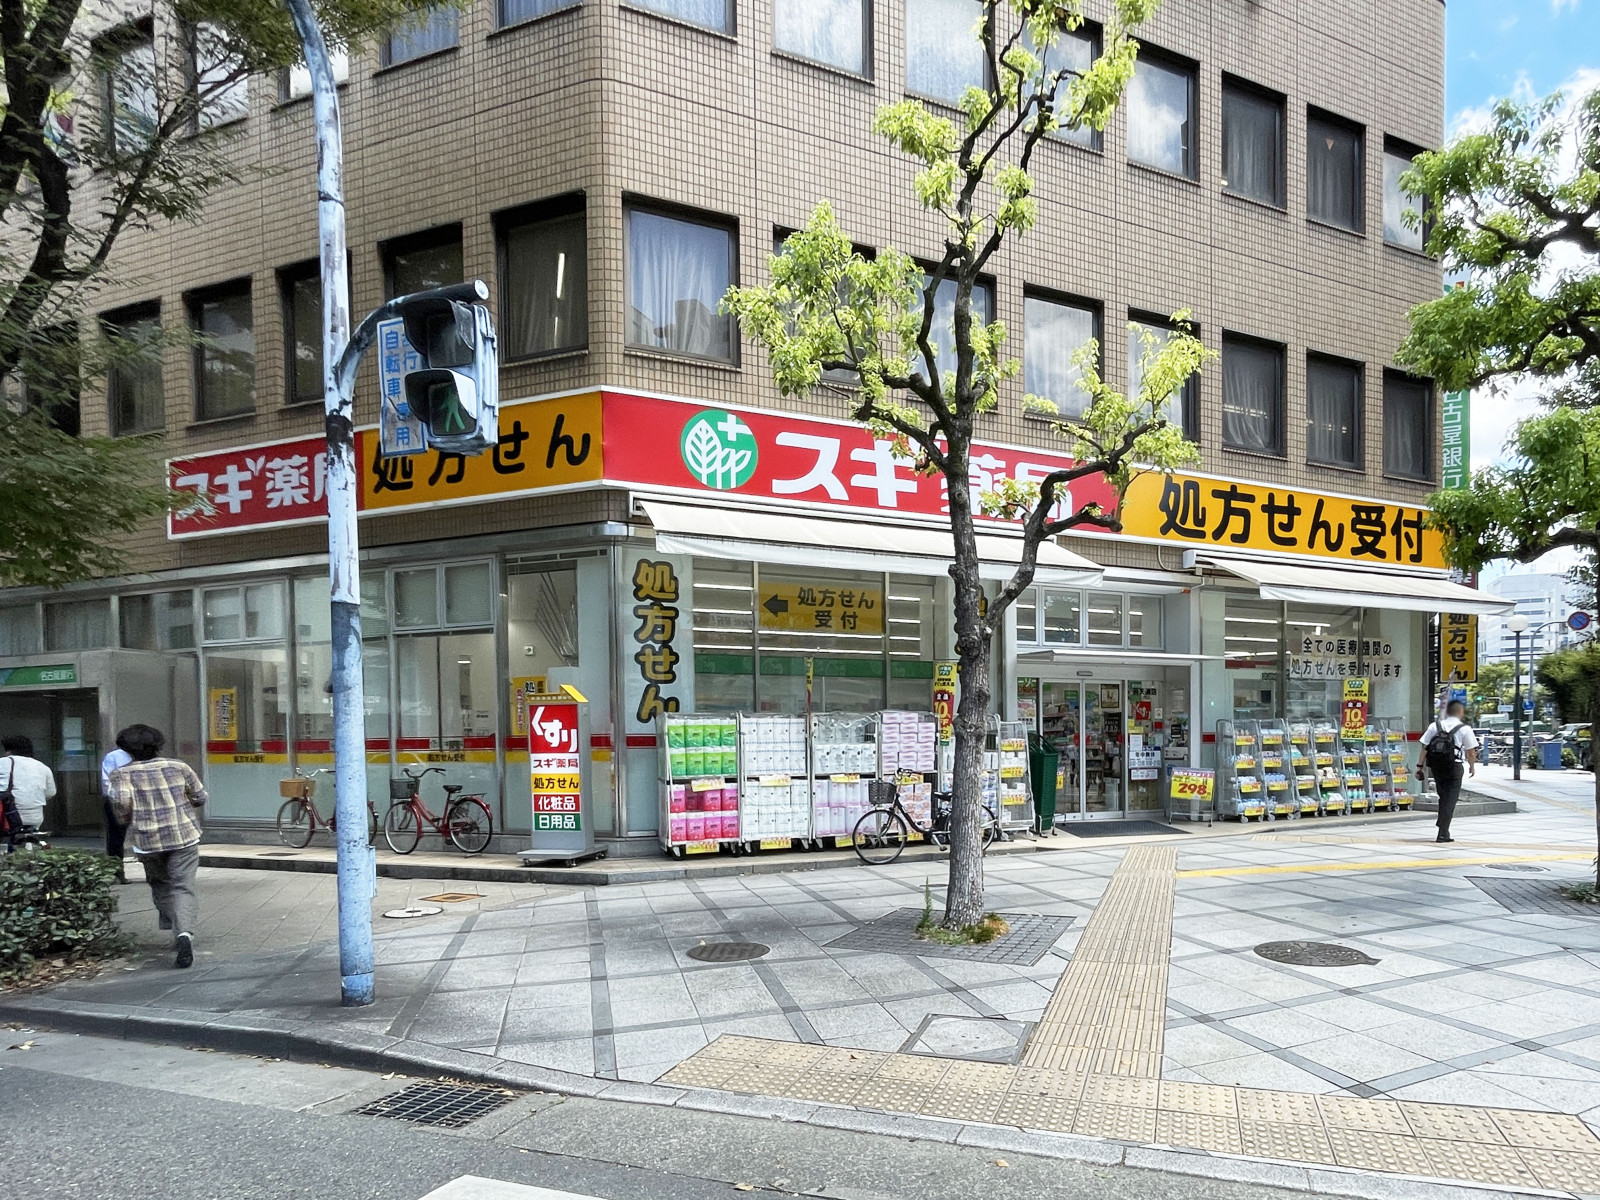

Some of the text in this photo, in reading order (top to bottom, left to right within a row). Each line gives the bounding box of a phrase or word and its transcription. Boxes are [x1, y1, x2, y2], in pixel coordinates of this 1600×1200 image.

[385, 330, 400, 397] 自転車
[1159, 474, 1426, 563] 処方せん受付
[797, 587, 875, 610] 処方せん
[814, 610, 859, 630] 受付
[633, 558, 680, 723] 処方せん
[531, 706, 578, 753] くすり
[533, 758, 579, 769] スギ薬局
[533, 777, 579, 789] 処方せん
[1178, 783, 1207, 795] 298
[538, 796, 576, 811] 化粧品
[538, 814, 576, 829] 日用品
